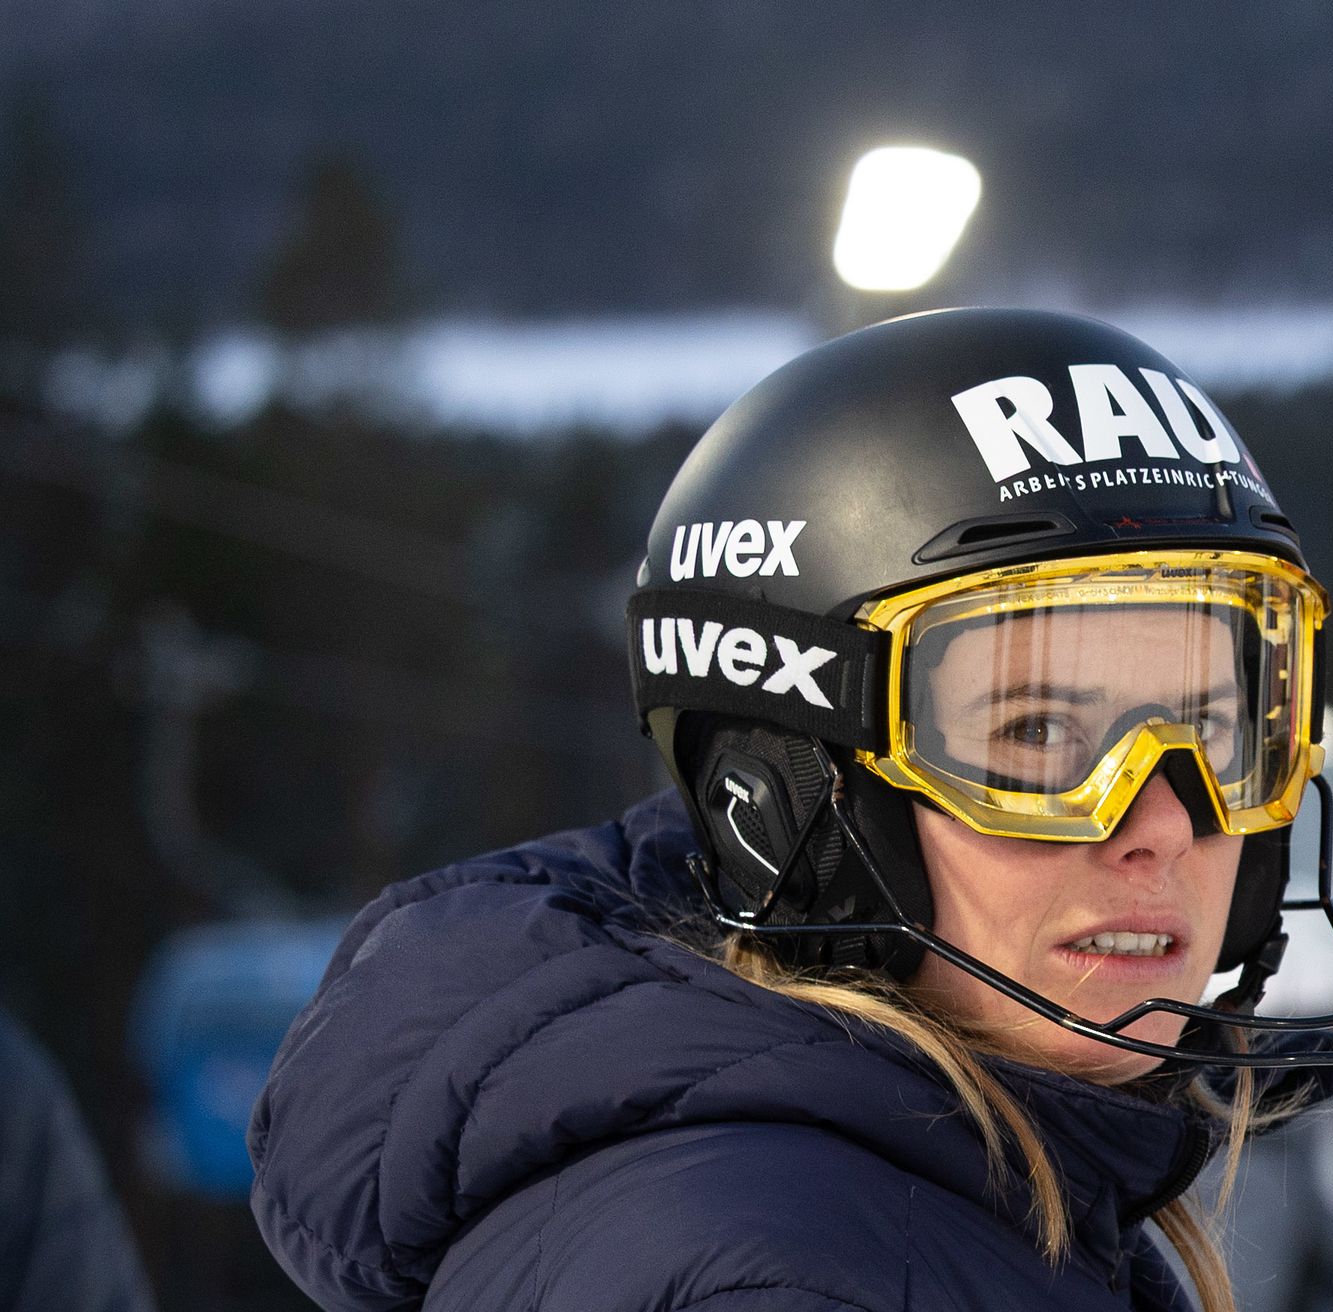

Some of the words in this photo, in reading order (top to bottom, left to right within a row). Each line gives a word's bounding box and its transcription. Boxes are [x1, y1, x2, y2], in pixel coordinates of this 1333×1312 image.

[951, 364, 1240, 482] RAU
[670, 519, 807, 582] uvex
[642, 617, 838, 710] uvex
